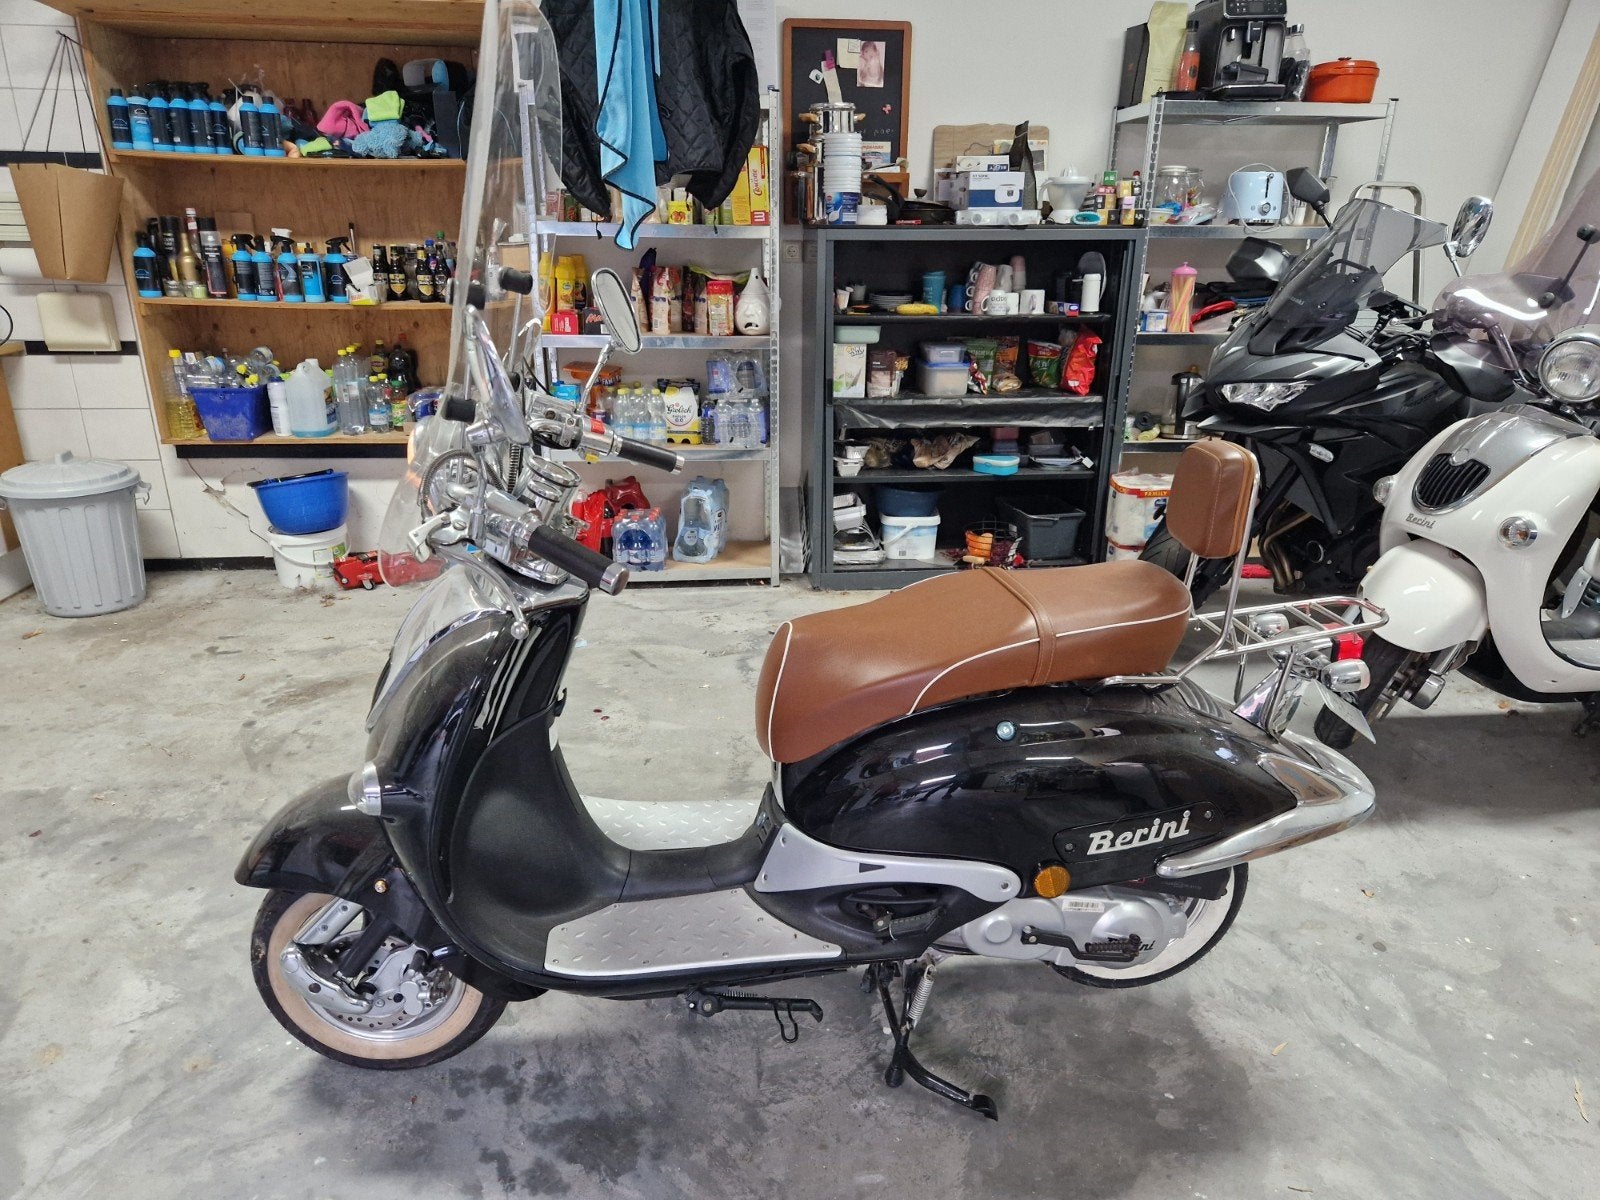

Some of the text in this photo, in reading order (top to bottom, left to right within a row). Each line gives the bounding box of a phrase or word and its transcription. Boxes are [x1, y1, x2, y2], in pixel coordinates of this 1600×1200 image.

[666, 403, 693, 415] Grolsch
[1405, 512, 1437, 529] Berini
[1087, 810, 1191, 855] Berini
